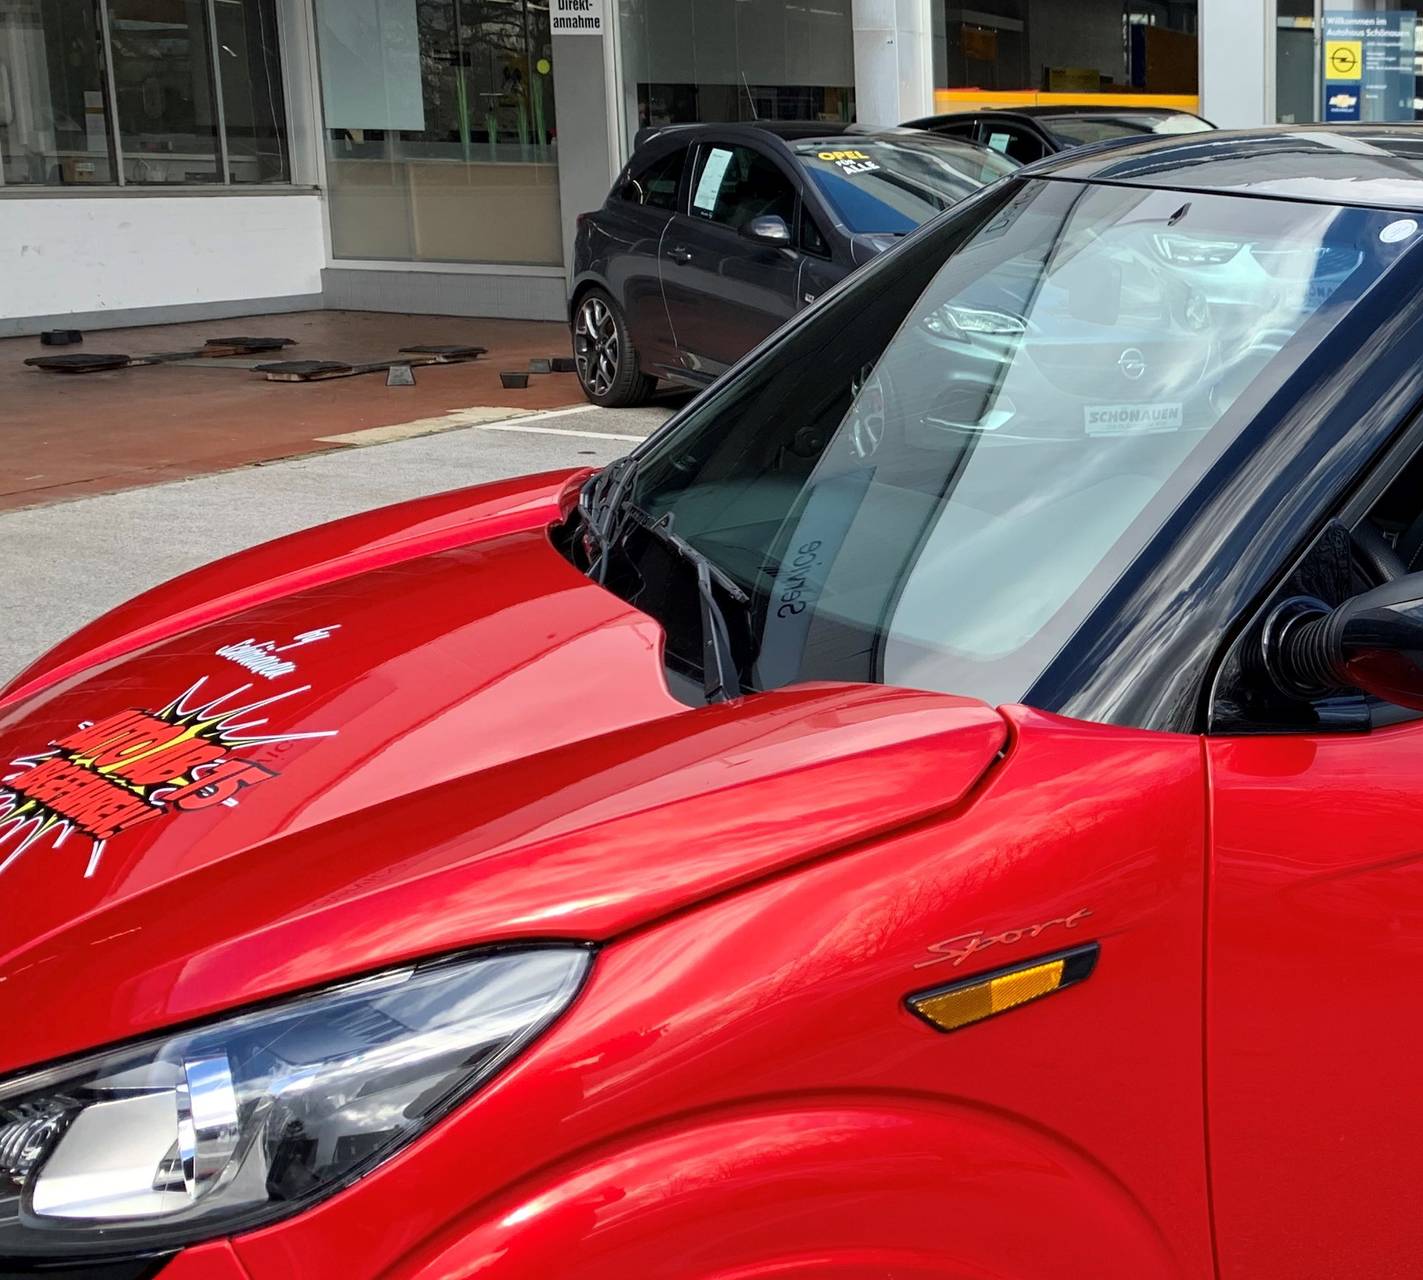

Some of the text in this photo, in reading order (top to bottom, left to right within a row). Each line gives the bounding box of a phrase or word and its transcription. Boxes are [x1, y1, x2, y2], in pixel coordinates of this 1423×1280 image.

[553, 15, 600, 28] annahme
[818, 150, 870, 161] OPEL
[843, 160, 880, 175] ALLE
[57, 708, 189, 772] AUTO
[157, 757, 281, 813] 15
[912, 907, 1093, 969] Sport
